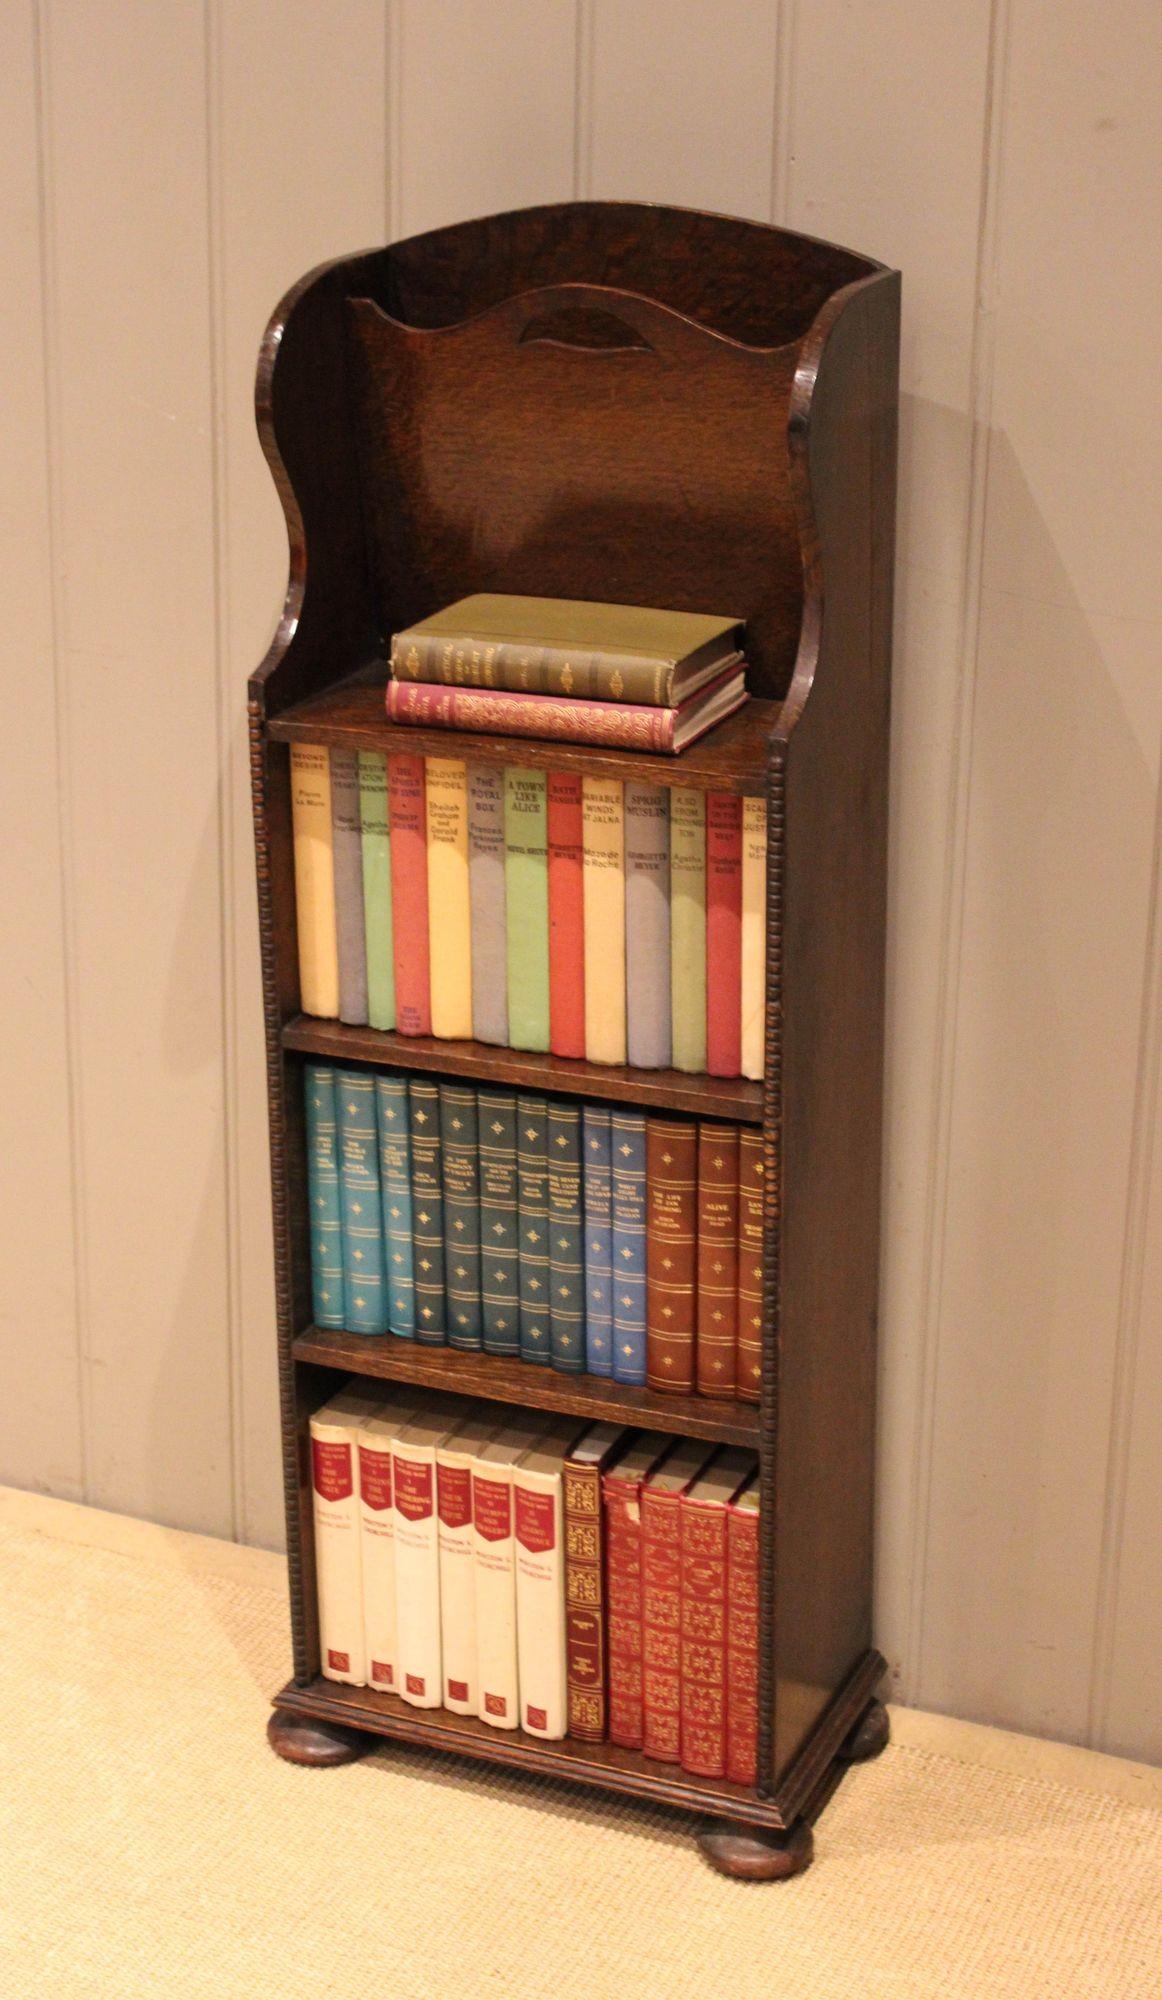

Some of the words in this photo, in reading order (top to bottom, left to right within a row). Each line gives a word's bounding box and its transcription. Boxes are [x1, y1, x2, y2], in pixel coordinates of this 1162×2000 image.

[476, 777, 495, 787] THE
[509, 781, 514, 790] A
[516, 782, 545, 792] TOWN
[470, 788, 501, 800] ROYAL
[515, 792, 538, 802] LIKE
[630, 794, 664, 805] SPRIG
[476, 802, 495, 812] BOX
[512, 802, 540, 812] ALICE
[586, 804, 616, 814] WINDS
[626, 806, 667, 817] MUSLIN
[674, 807, 698, 816] FROM
[592, 814, 620, 824] JALNA
[705, 1203, 729, 1211] ALIVE
